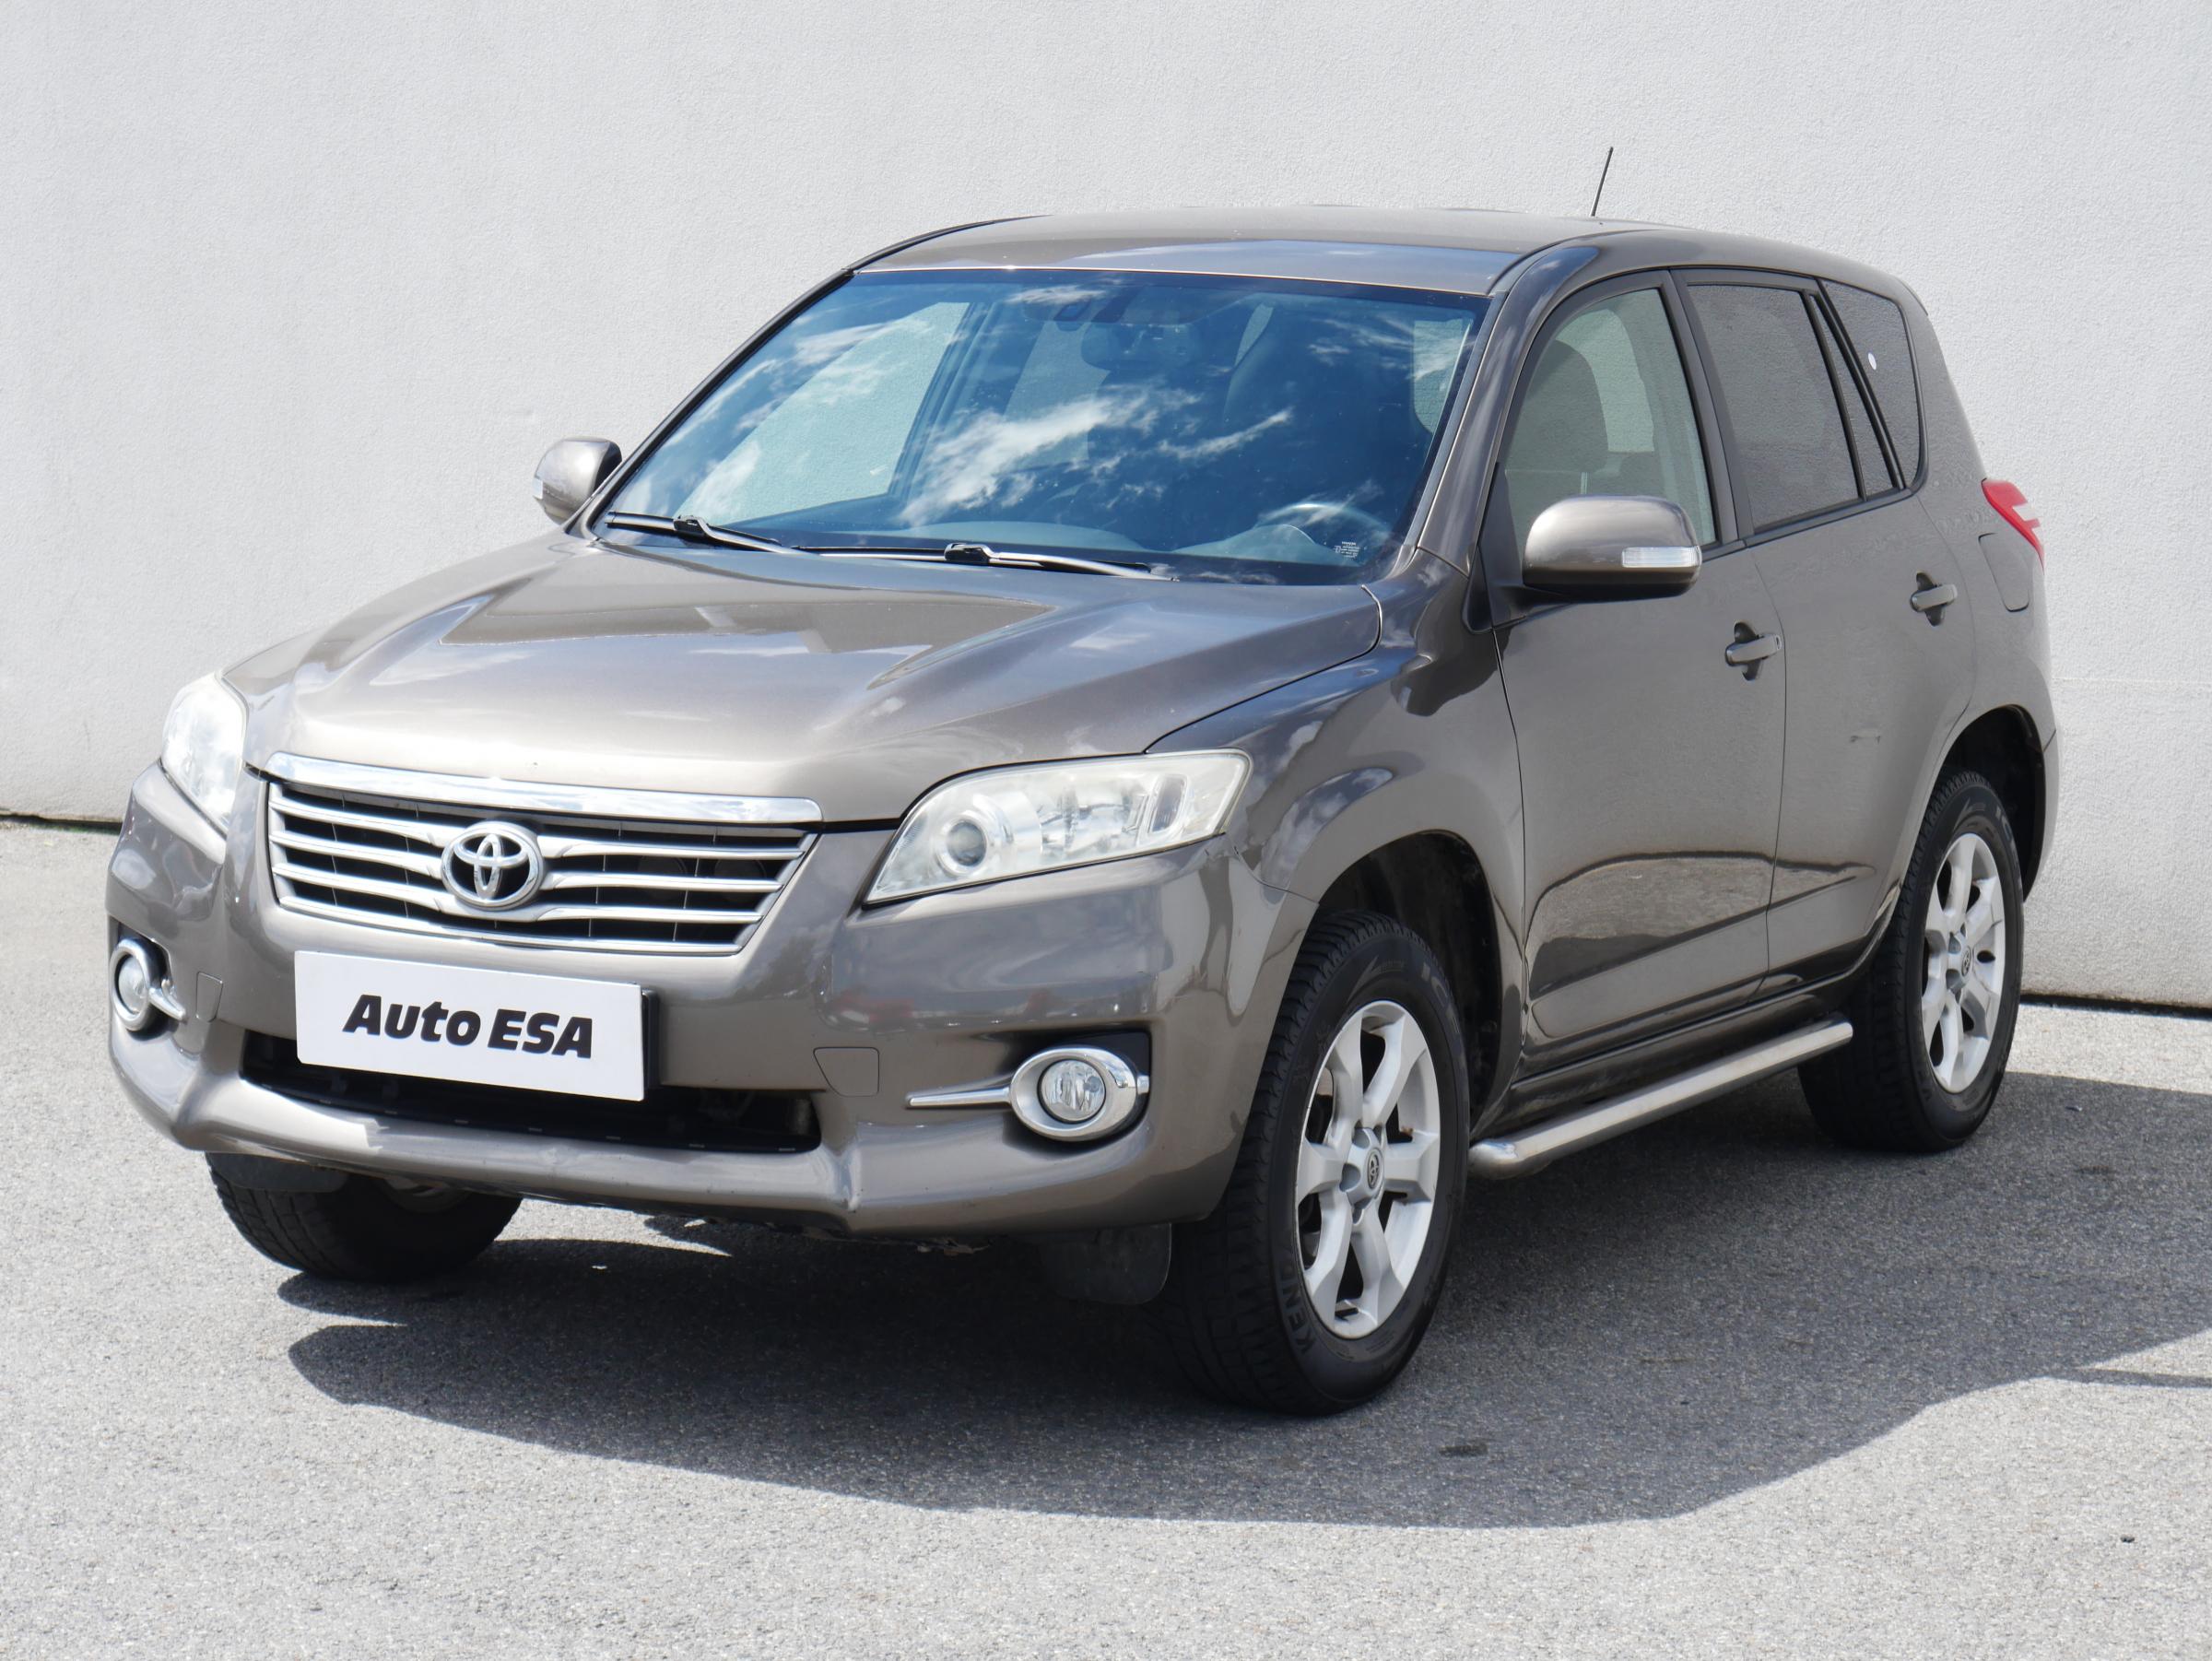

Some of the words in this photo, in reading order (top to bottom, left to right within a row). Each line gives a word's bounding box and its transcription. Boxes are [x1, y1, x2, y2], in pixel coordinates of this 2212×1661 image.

[342, 994, 481, 1046] Auto
[487, 1008, 593, 1059] ESA
[1279, 1242, 1318, 1355] KEND
